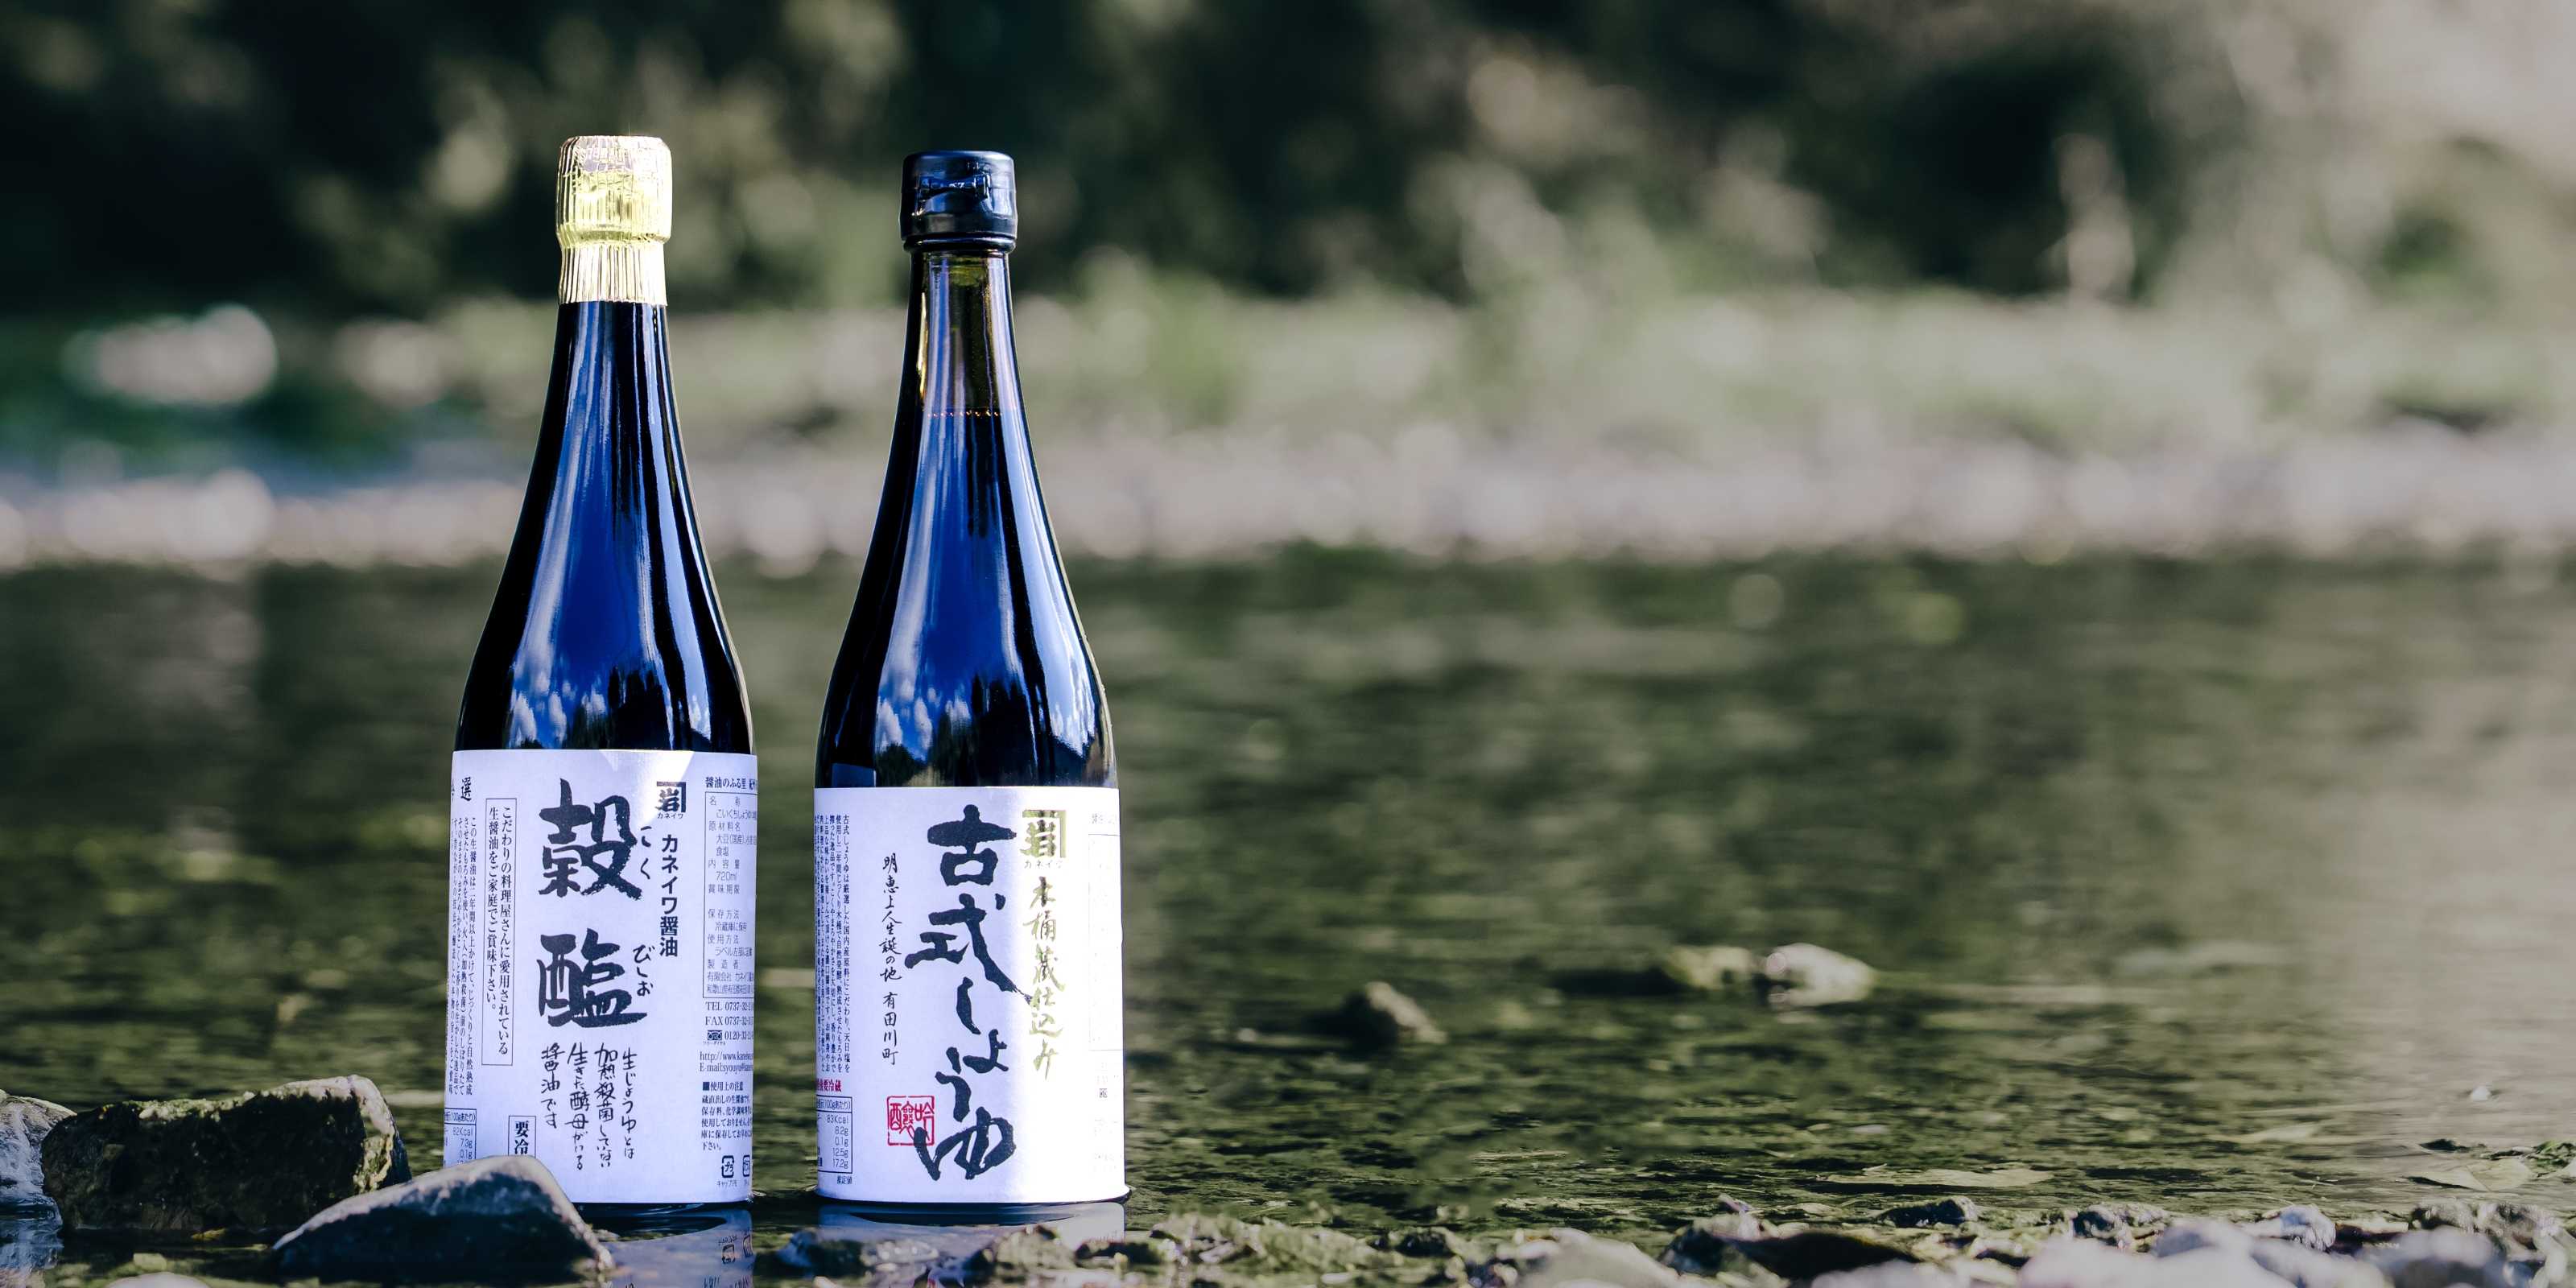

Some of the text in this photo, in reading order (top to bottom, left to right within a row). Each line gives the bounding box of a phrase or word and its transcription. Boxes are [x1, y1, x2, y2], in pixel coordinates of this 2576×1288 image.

[705, 776, 747, 790] 醤油のふる里
[460, 776, 473, 802] 選
[708, 820, 741, 832] 原材料名
[716, 846, 729, 857] 食塩
[716, 871, 737, 881] 720ml
[708, 884, 740, 894] 賞味期限
[659, 833, 679, 957] カネイワ醤油
[486, 807, 499, 1009] 生醤油をご家庭でご賞味下さい。
[708, 909, 740, 919] 保存方法
[497, 807, 513, 1055] こだわりの料理屋さんに愛用されている
[708, 934, 739, 944] 使用方法
[879, 852, 902, 1065] 明恵上人生誕の地 有田川町
[904, 804, 1039, 1181] 古式しょうゆ
[705, 1001, 723, 1011] TEL
[705, 1016, 723, 1026] FAX
[540, 1042, 565, 1129] 醤油です
[564, 1042, 590, 1170] 生きた酵母がいる
[594, 1042, 619, 1167] 加熱殺菌していない
[621, 1046, 638, 1159] 生じょうゆとは
[827, 1114, 848, 1124] 83Kcal
[452, 1127, 473, 1137] 82Kcal
[835, 1125, 848, 1137] 8.2g
[460, 1138, 473, 1149] 7.3g
[700, 1141, 722, 1151] 下さい。
[835, 1136, 848, 1147] 0.1g
[460, 1150, 473, 1159] 0.1g
[832, 1147, 848, 1158] 12.5g
[832, 1158, 848, 1169] 17.2g
